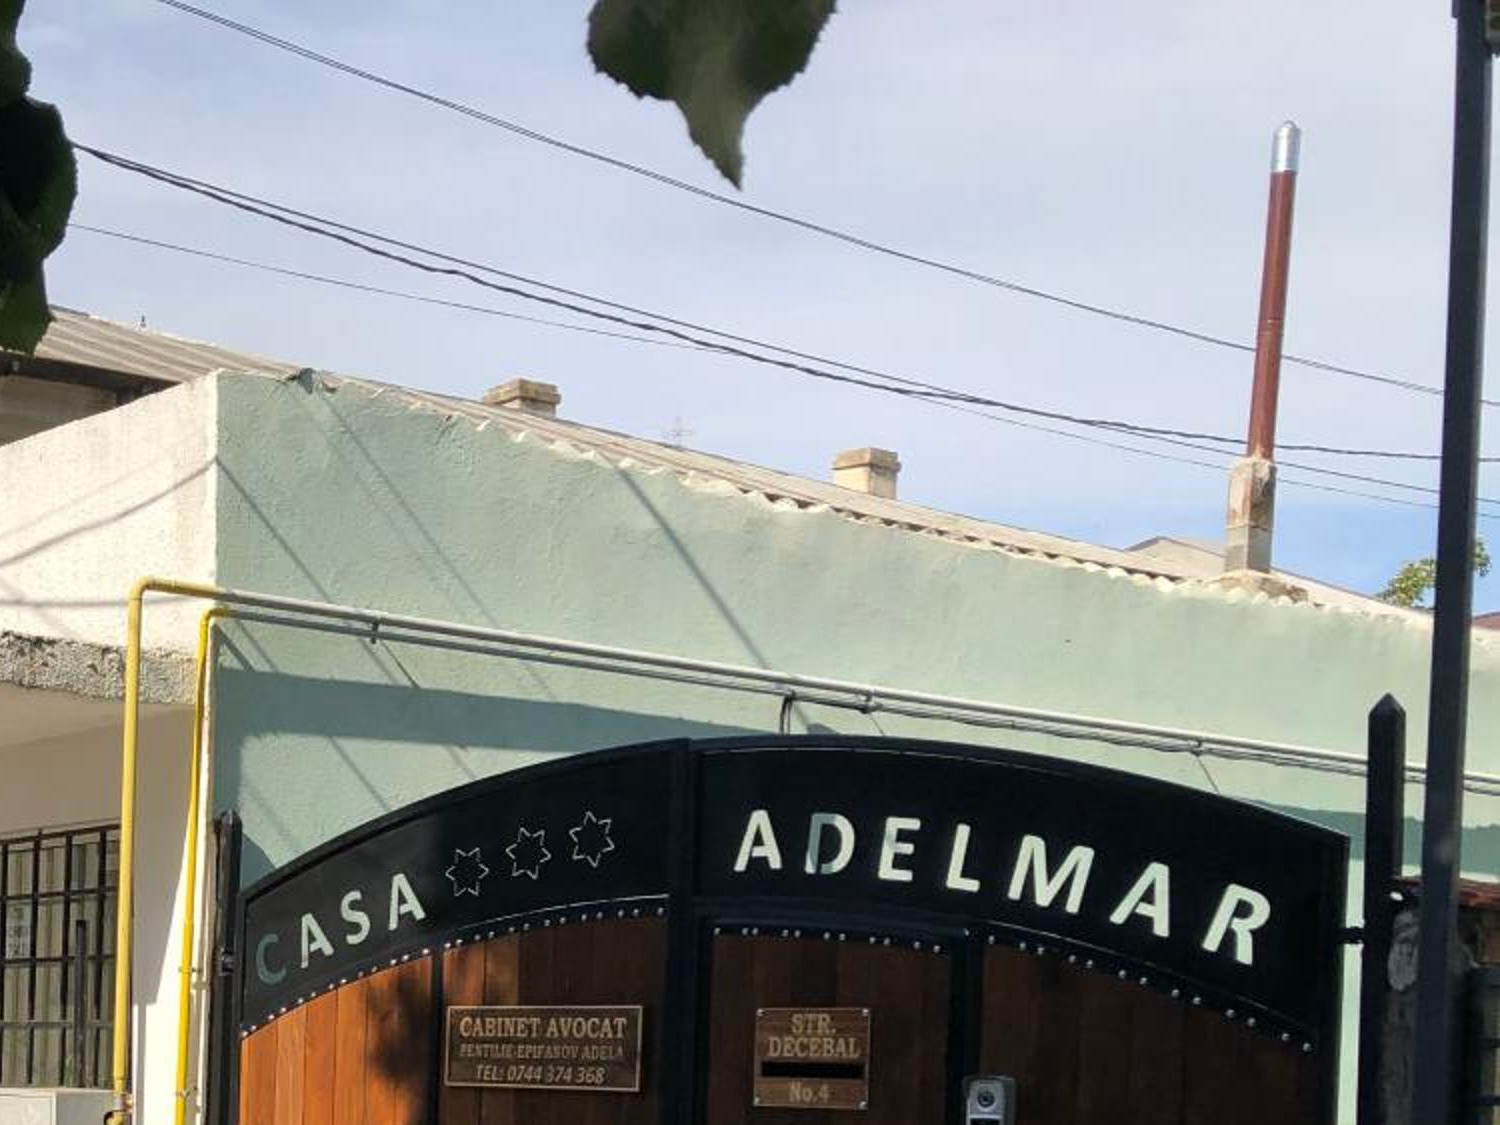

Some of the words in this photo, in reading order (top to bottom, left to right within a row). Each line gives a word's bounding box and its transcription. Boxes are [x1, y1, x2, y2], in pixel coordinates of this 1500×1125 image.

[256, 873, 426, 984] CASA
[733, 809, 1271, 965] ADELMAR
[459, 1017, 541, 1038] CABINET
[546, 1017, 627, 1039] AVOCAT
[791, 1013, 837, 1034] STR.
[768, 1036, 861, 1058] DECEBAL
[476, 1063, 504, 1081] TEL:
[507, 1065, 543, 1082] 0744
